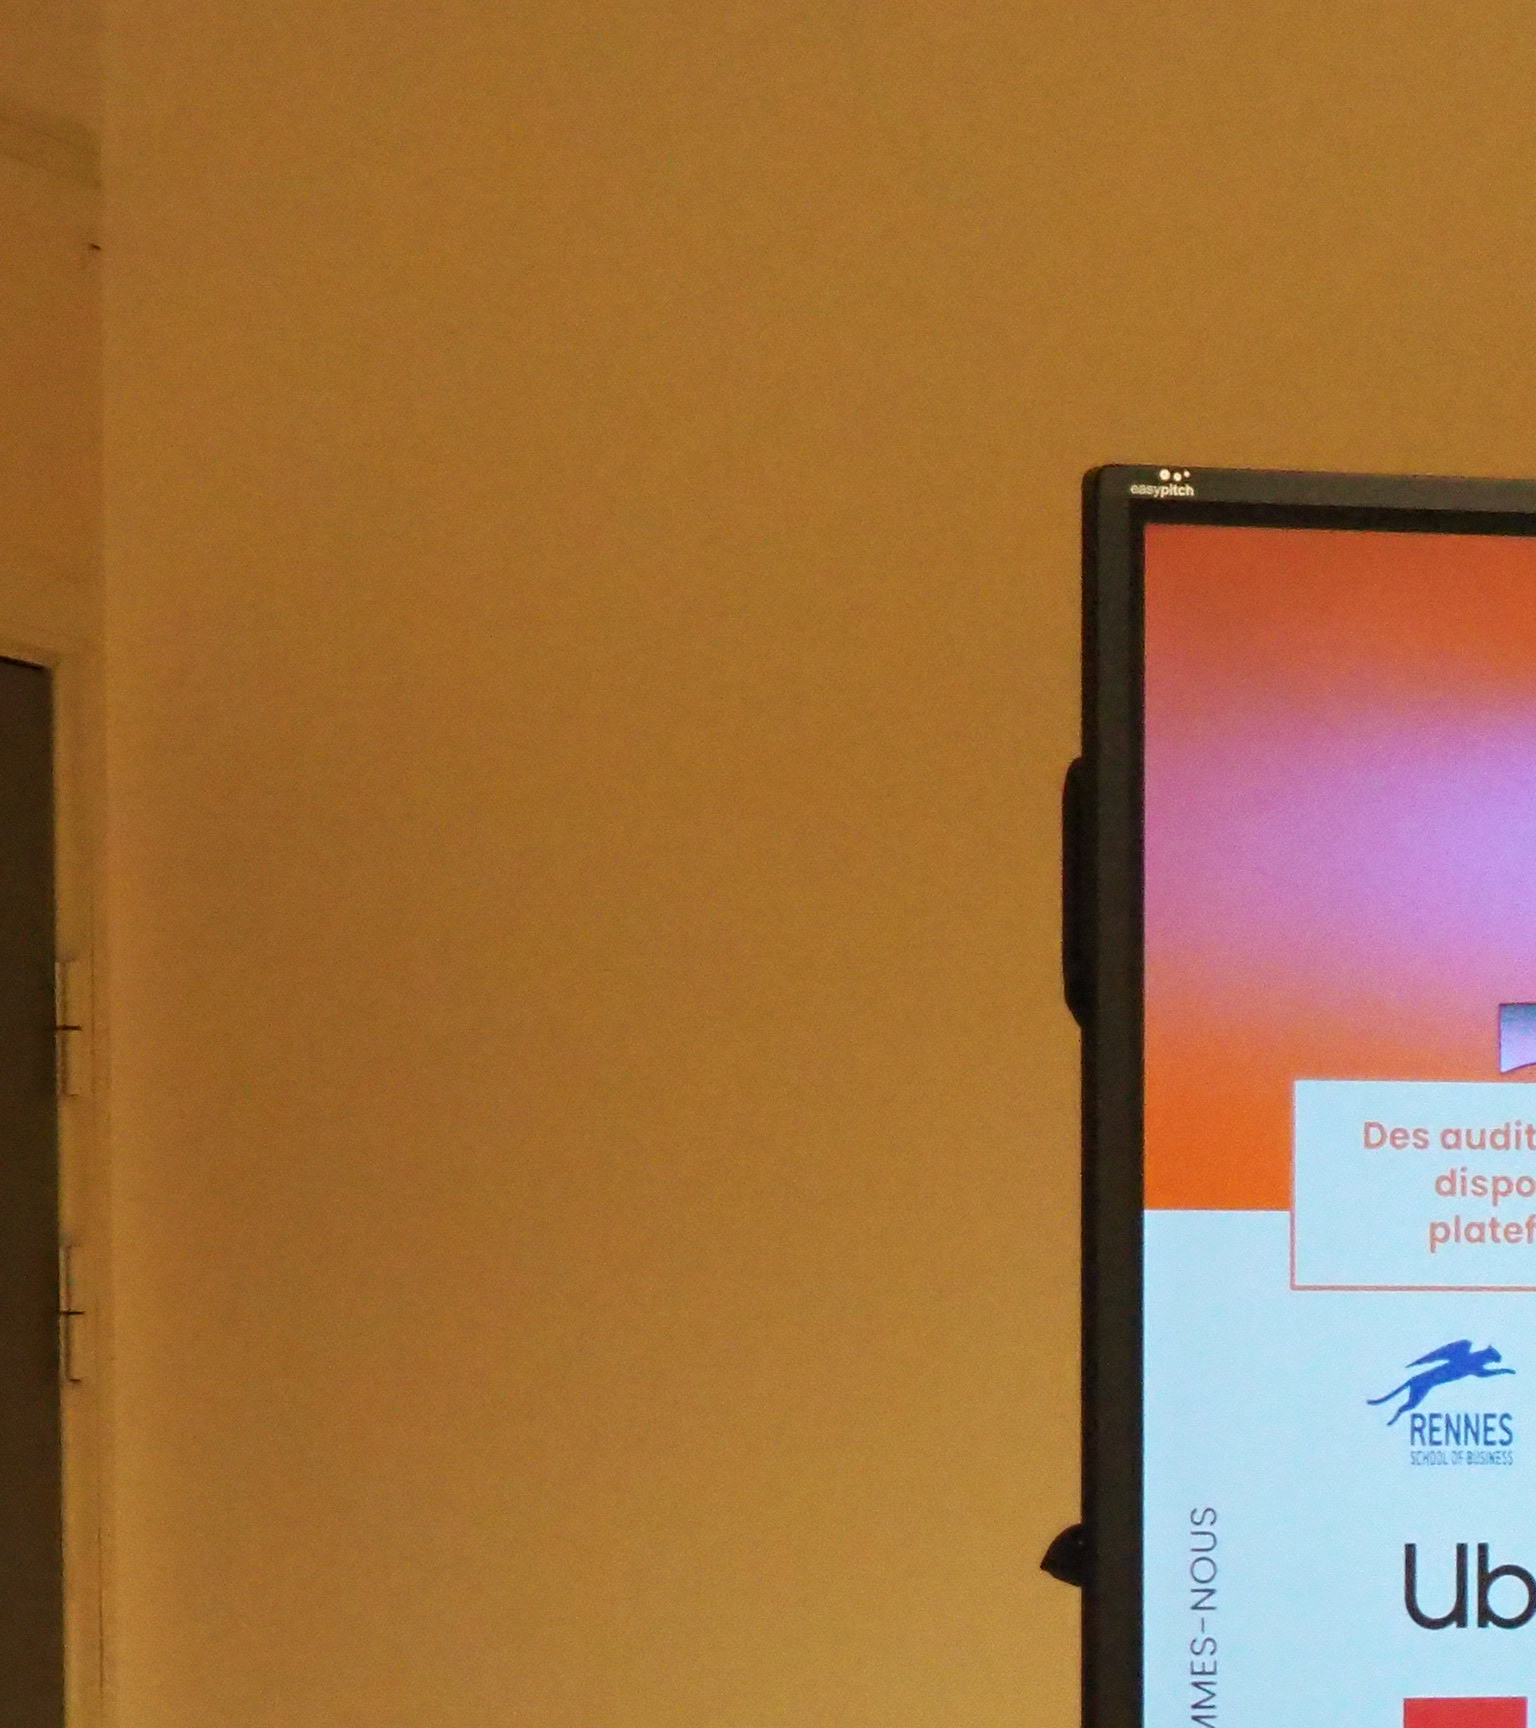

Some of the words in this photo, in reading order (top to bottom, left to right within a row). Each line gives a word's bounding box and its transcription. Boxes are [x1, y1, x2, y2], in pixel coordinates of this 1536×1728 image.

[1130, 483, 1195, 498] easypitch
[1364, 1122, 1429, 1151] Des
[1410, 1413, 1514, 1446] RENNES
